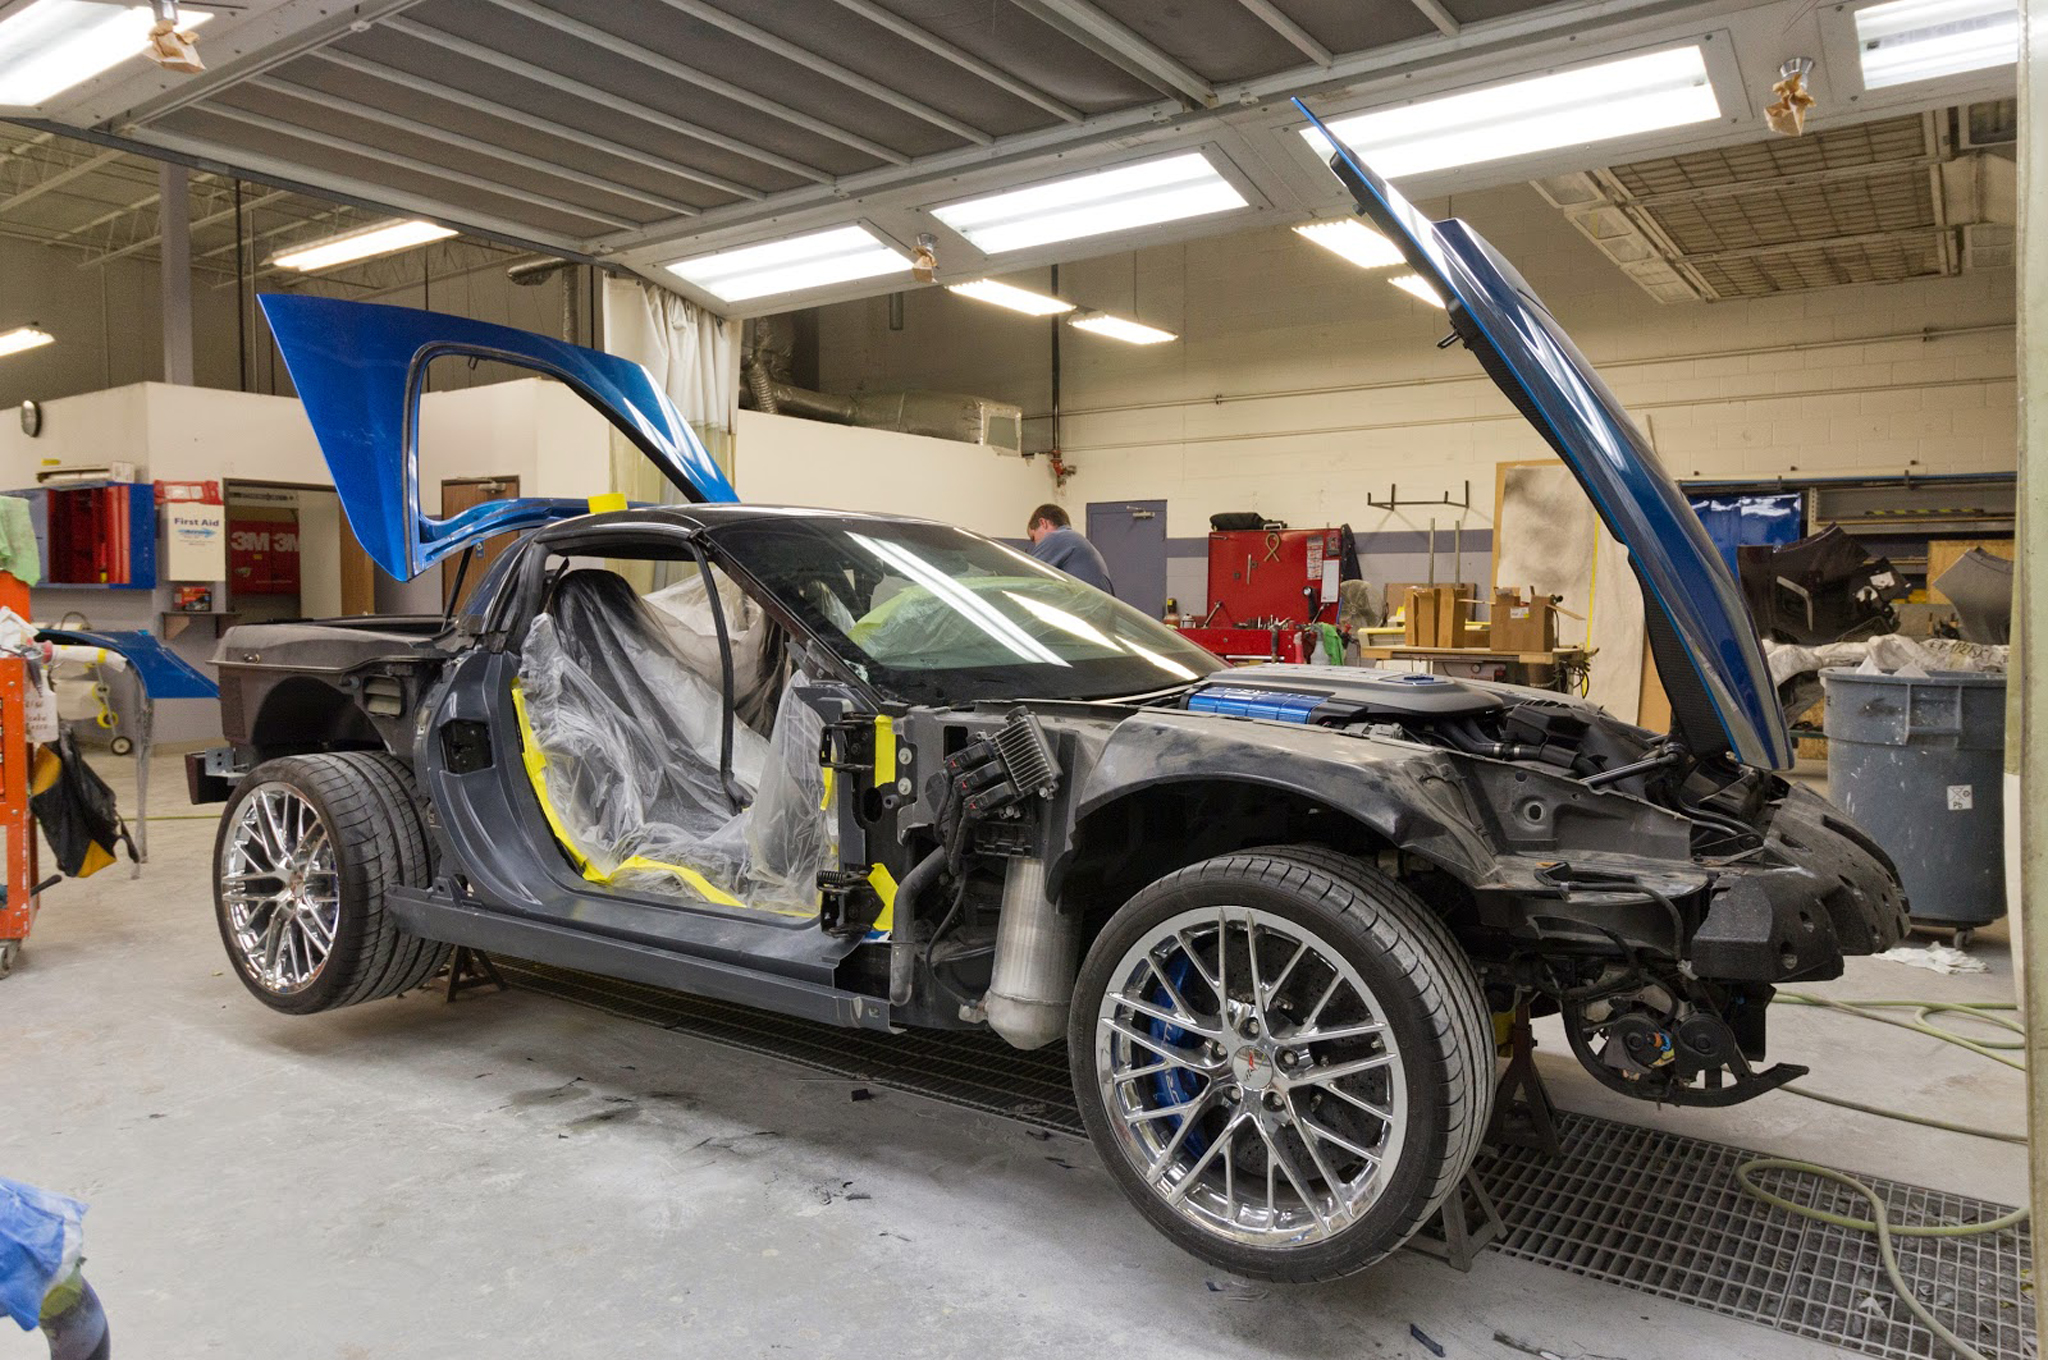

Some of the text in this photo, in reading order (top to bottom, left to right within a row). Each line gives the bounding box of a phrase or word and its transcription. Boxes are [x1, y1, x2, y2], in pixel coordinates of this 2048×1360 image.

[174, 517, 220, 527] First Aid
[231, 531, 270, 552] 3M
